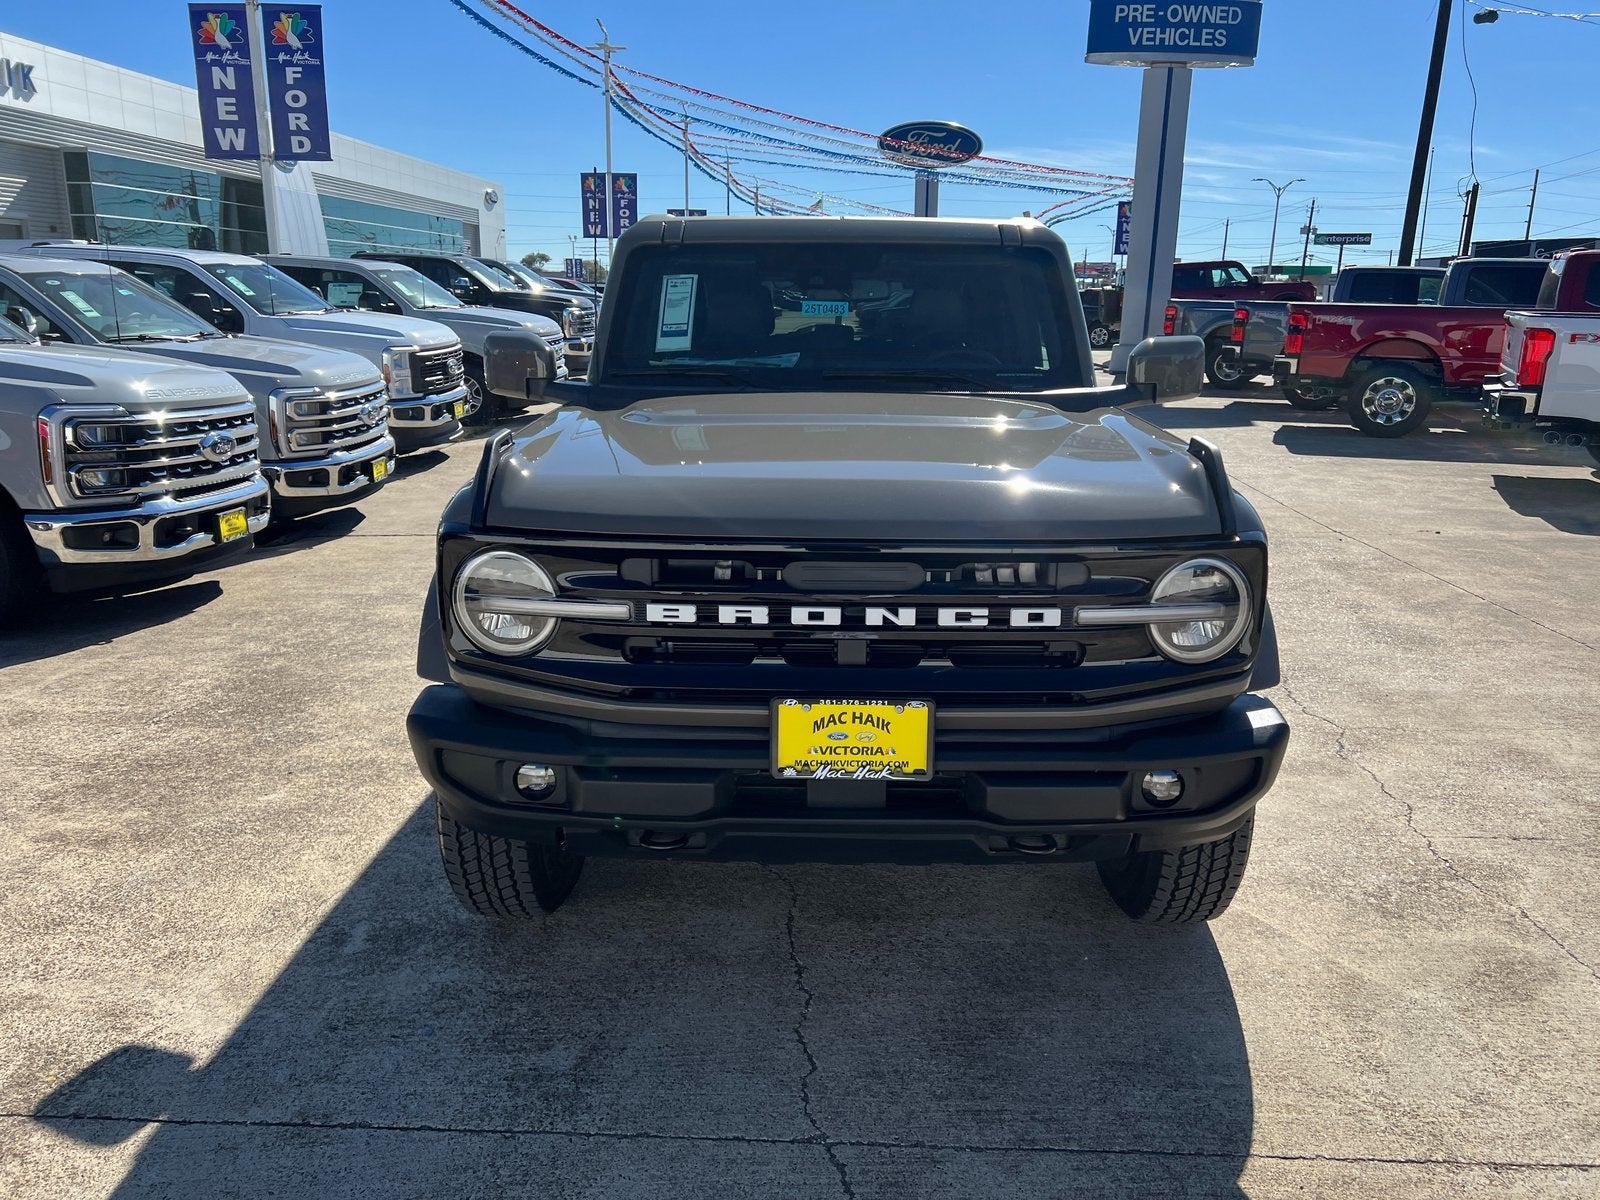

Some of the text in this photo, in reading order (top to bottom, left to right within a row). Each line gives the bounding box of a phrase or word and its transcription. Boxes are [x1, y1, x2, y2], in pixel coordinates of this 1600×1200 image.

[1114, 4, 1242, 24] PRE-OWNED
[1128, 27, 1227, 46] VEHICLES
[211, 66, 246, 151] NEW
[284, 66, 312, 154] FORD
[804, 303, 846, 315] 25T0483
[646, 602, 1062, 627] BRONCO
[812, 711, 891, 735] MAC HAIK
[819, 746, 884, 756] VICTORIA
[812, 764, 892, 780] Mac Haik
